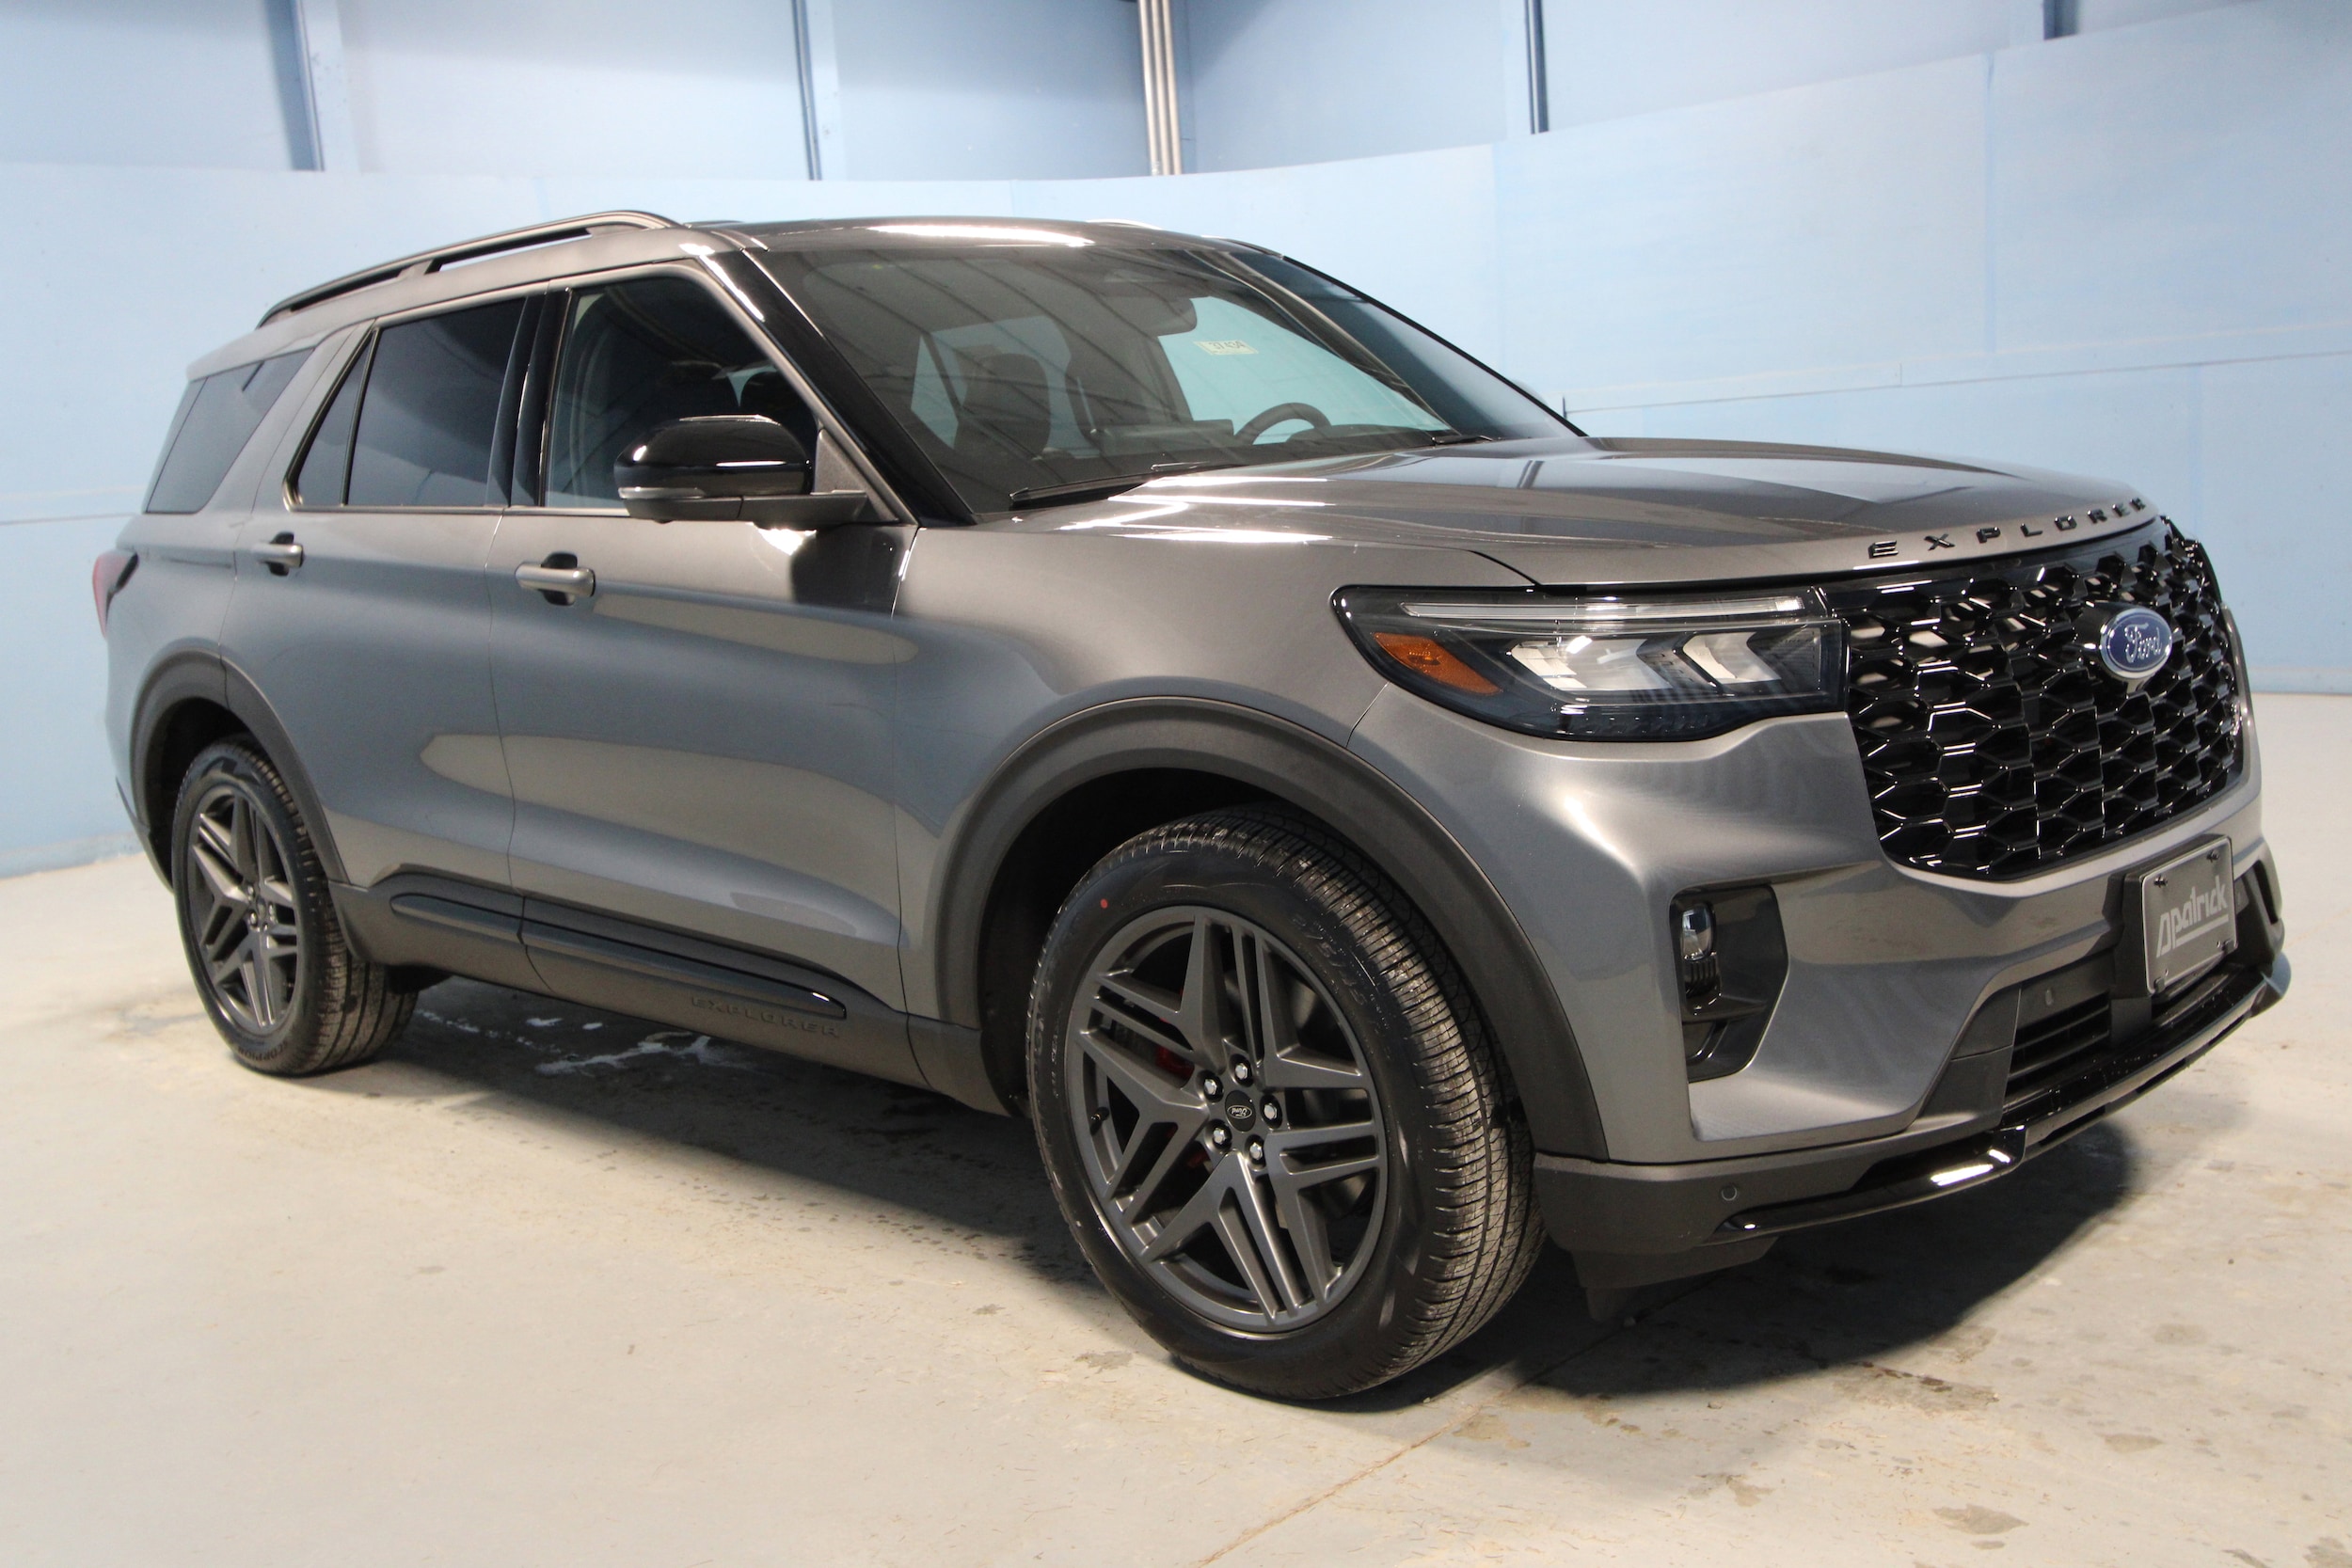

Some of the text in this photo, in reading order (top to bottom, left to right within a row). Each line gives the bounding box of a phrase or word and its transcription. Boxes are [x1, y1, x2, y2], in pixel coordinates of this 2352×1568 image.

[1868, 497, 2146, 559] EXPLORER
[2124, 622, 2163, 663] Ford
[691, 996, 840, 1038] EXPLORER
